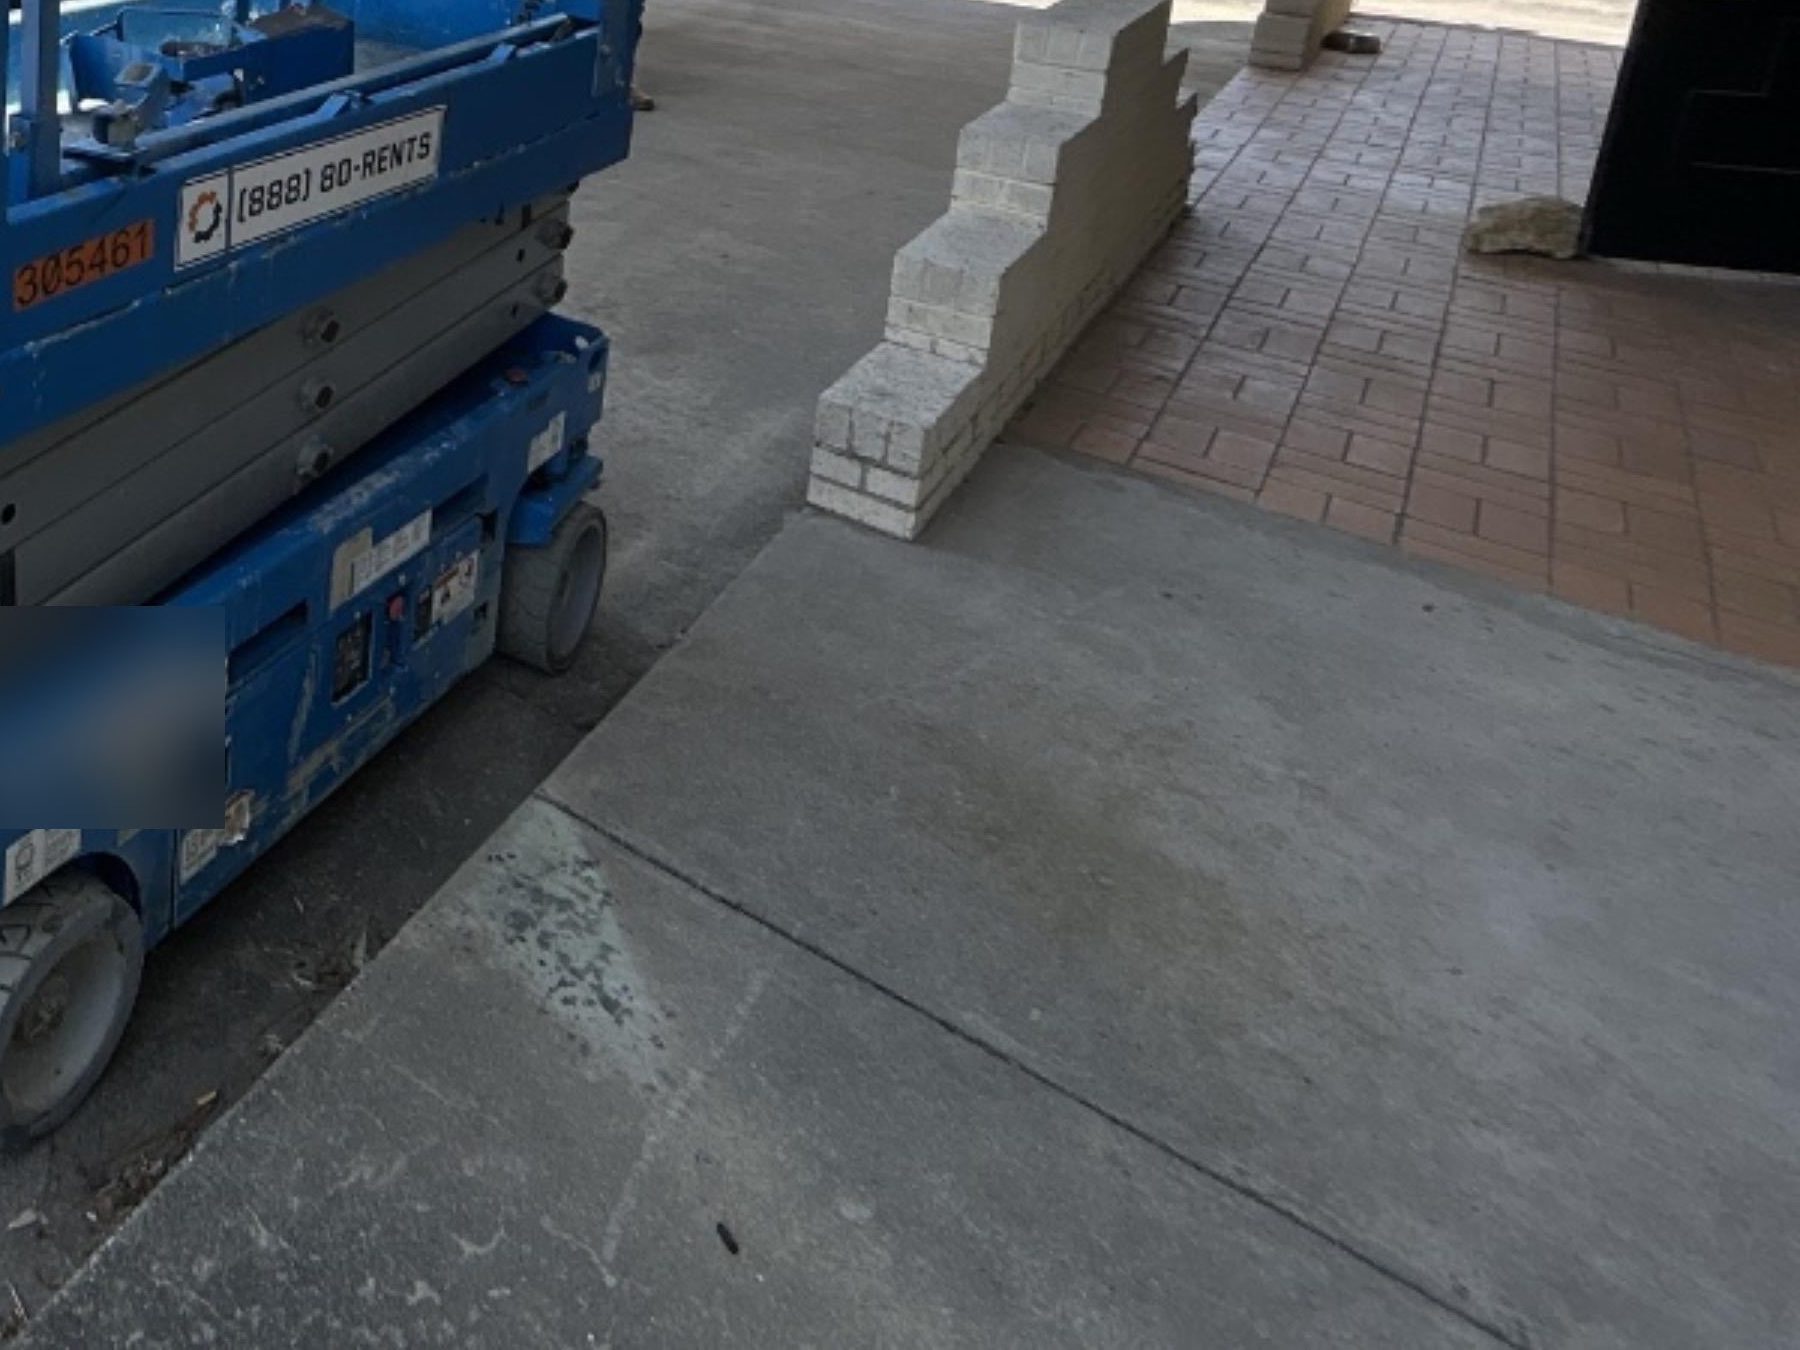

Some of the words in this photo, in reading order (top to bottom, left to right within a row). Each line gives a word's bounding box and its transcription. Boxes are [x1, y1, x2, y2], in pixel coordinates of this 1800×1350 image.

[237, 167, 312, 223] (888)
[319, 131, 432, 193] 80-RENTS
[15, 221, 149, 306] 305461
